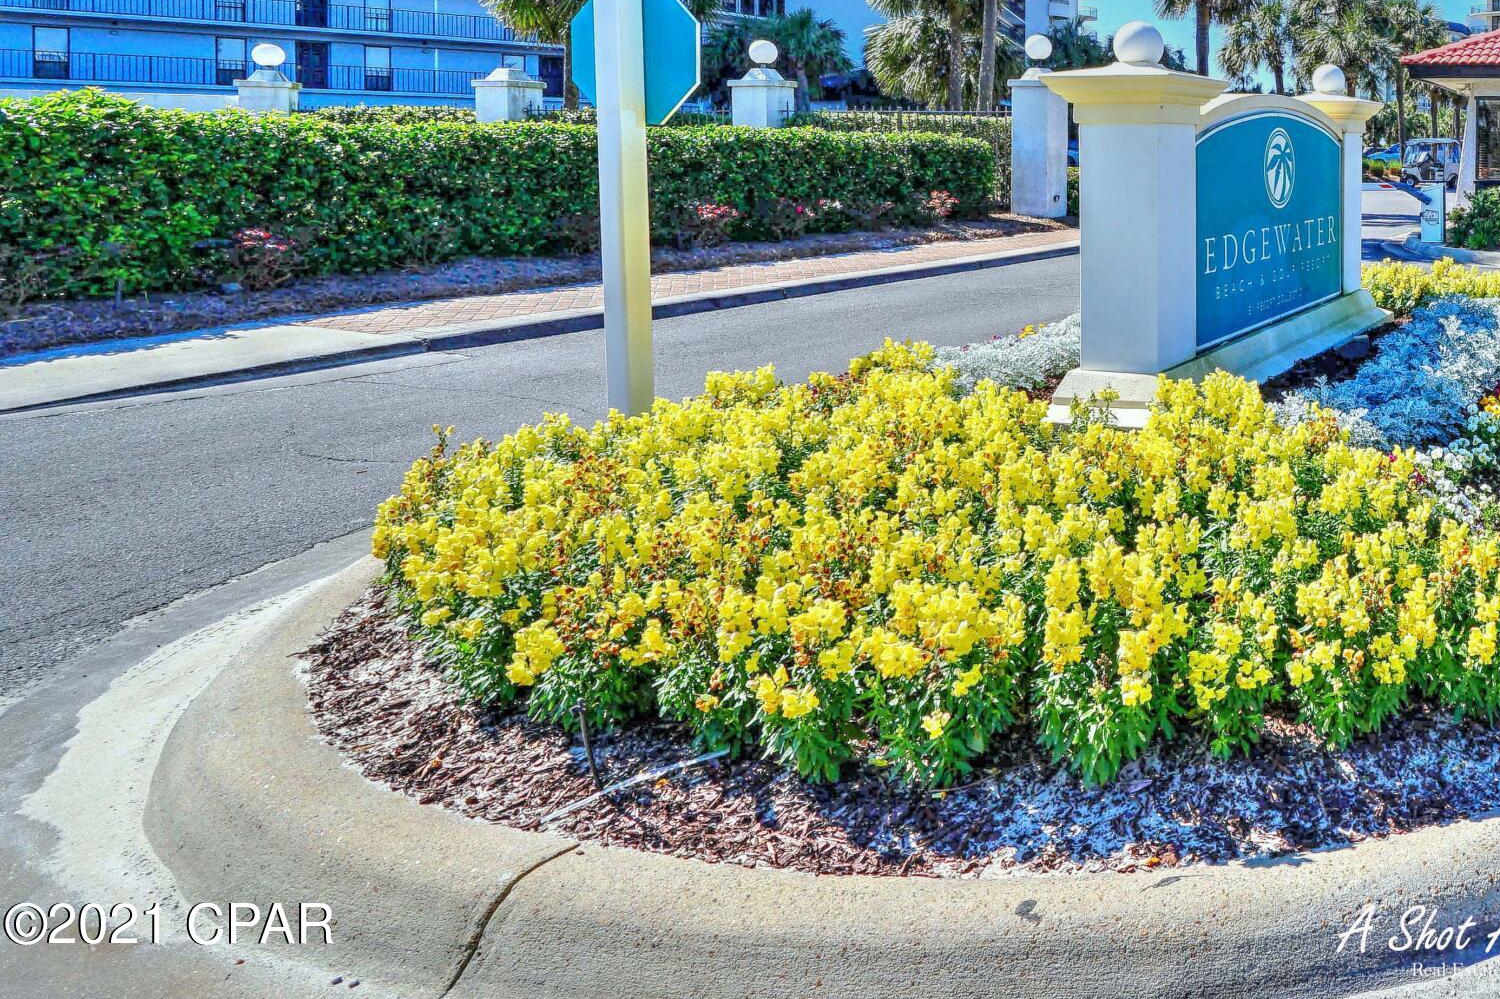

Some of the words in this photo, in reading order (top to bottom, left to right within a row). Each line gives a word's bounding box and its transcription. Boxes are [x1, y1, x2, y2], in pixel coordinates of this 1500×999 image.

[1204, 215, 1336, 274] EDGEWATER
[1215, 278, 1254, 300] BEACH
[1260, 272, 1266, 286] &
[1271, 263, 1297, 283] GOLF
